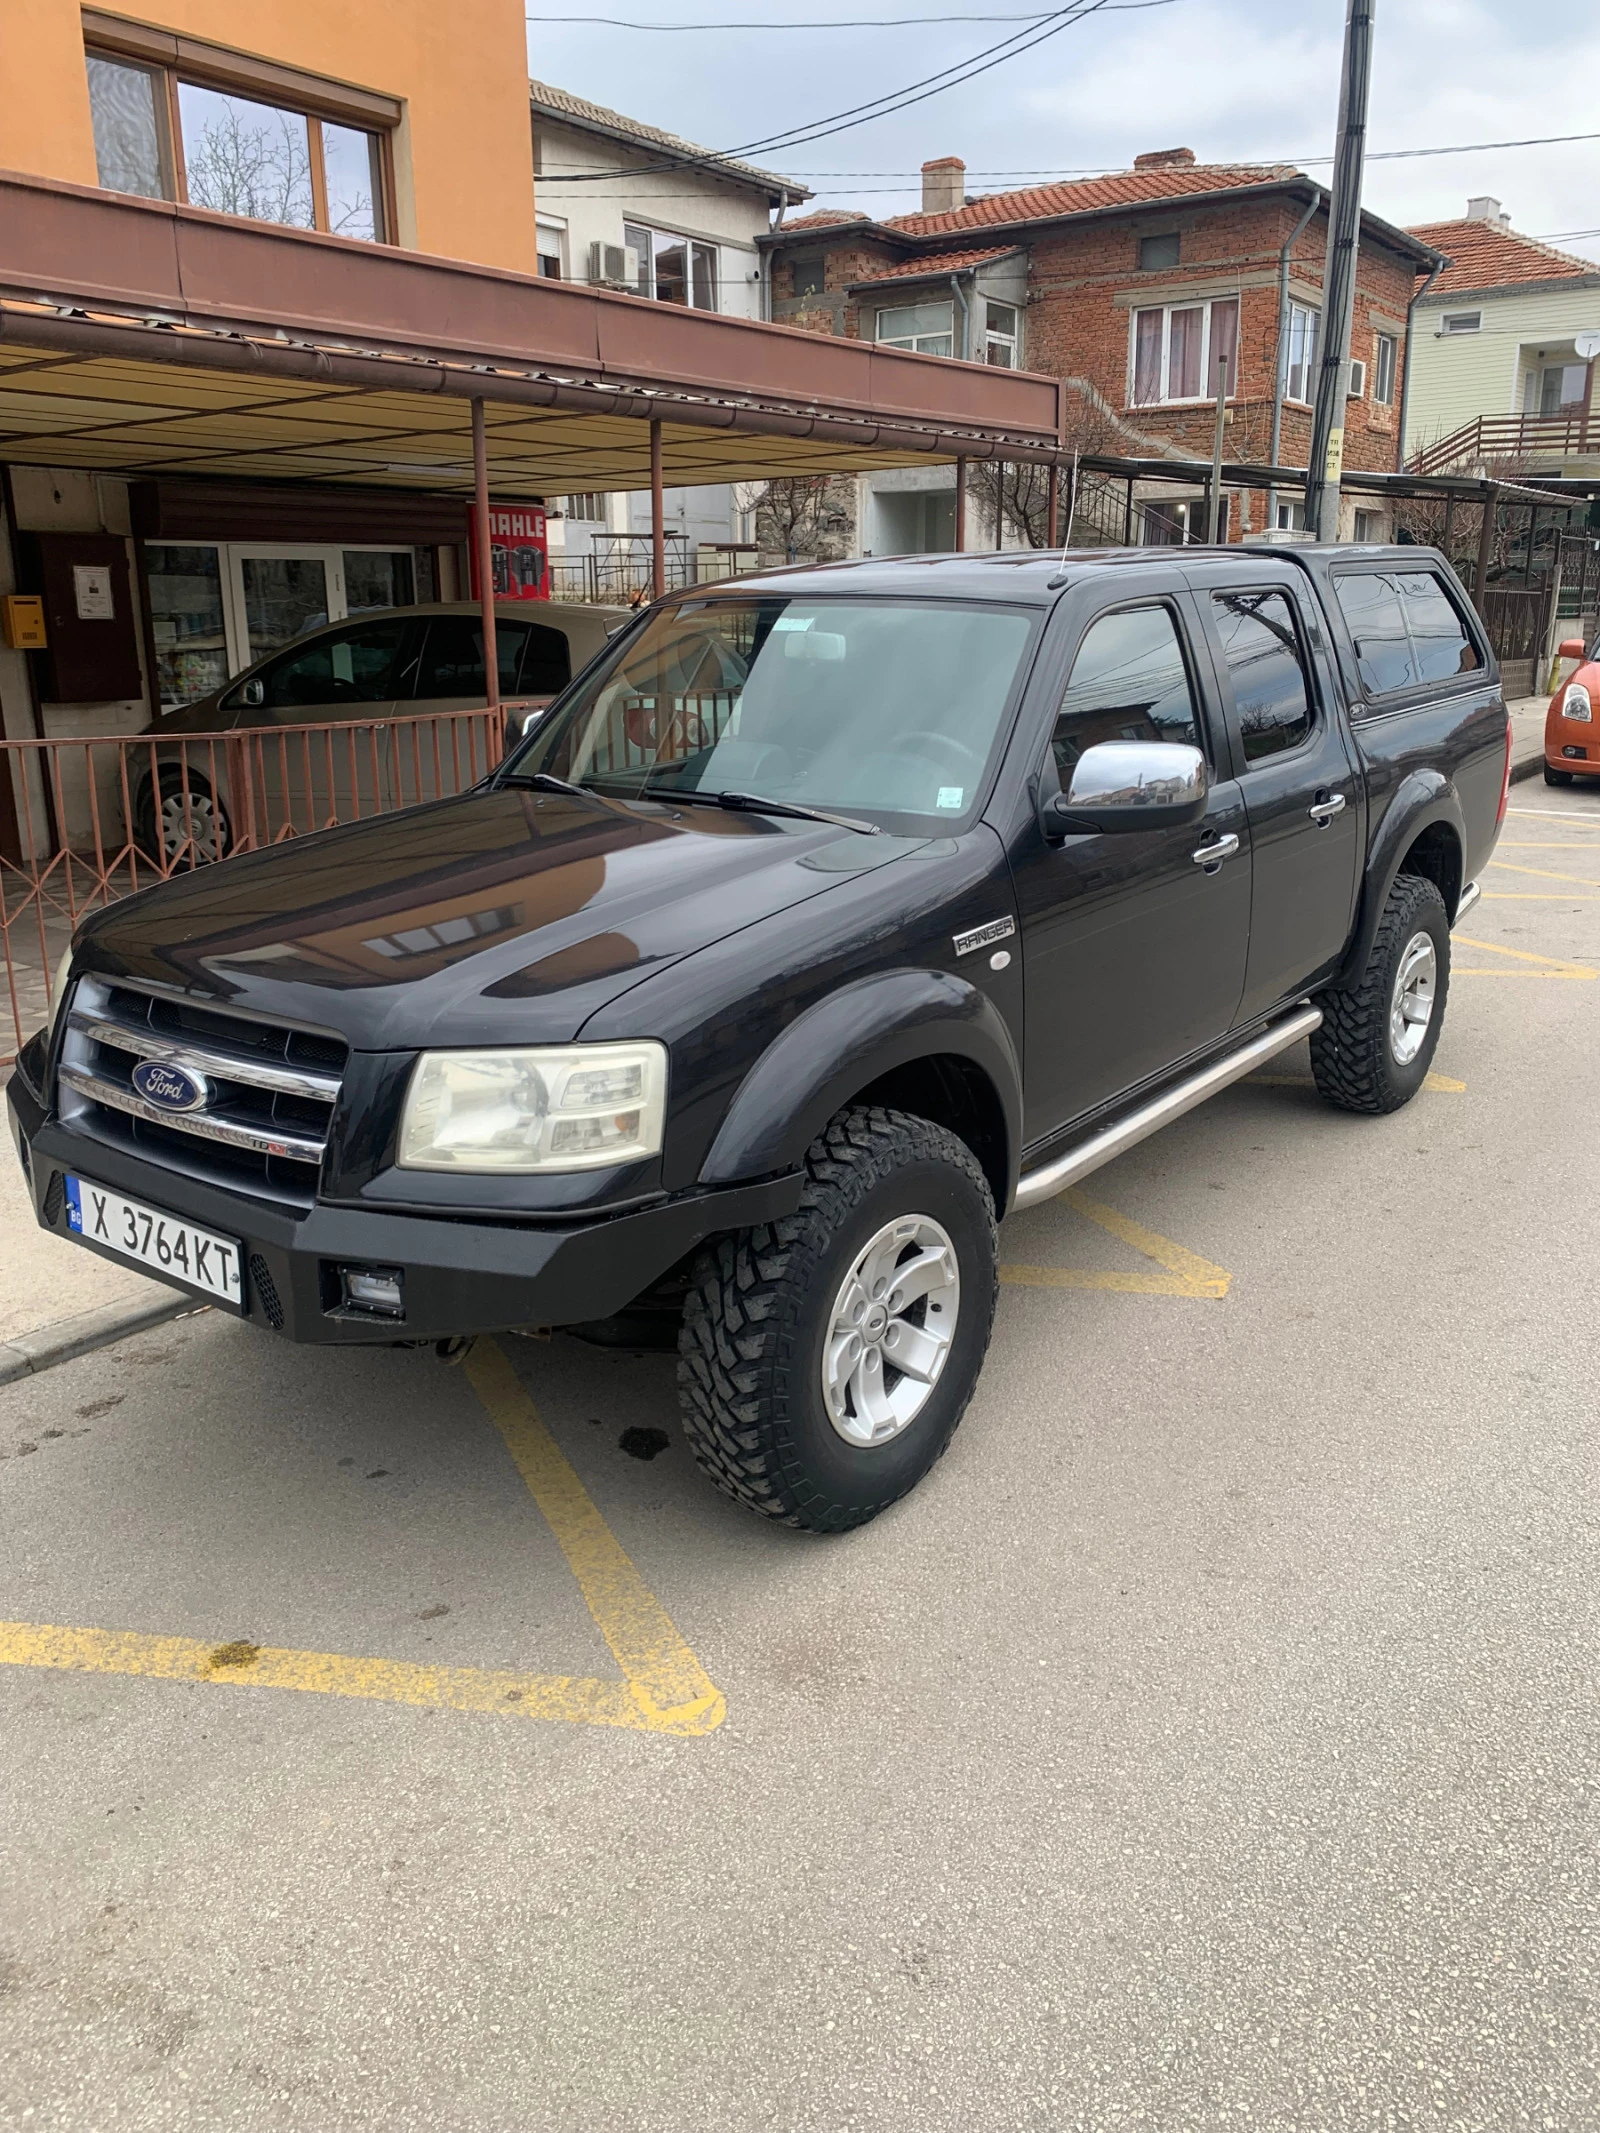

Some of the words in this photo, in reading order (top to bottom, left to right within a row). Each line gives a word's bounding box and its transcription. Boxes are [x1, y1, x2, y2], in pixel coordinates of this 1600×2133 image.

[957, 918, 1014, 952] RANGER
[145, 1067, 185, 1100] Ford
[71, 1209, 82, 1225] BG
[92, 1191, 110, 1240] X
